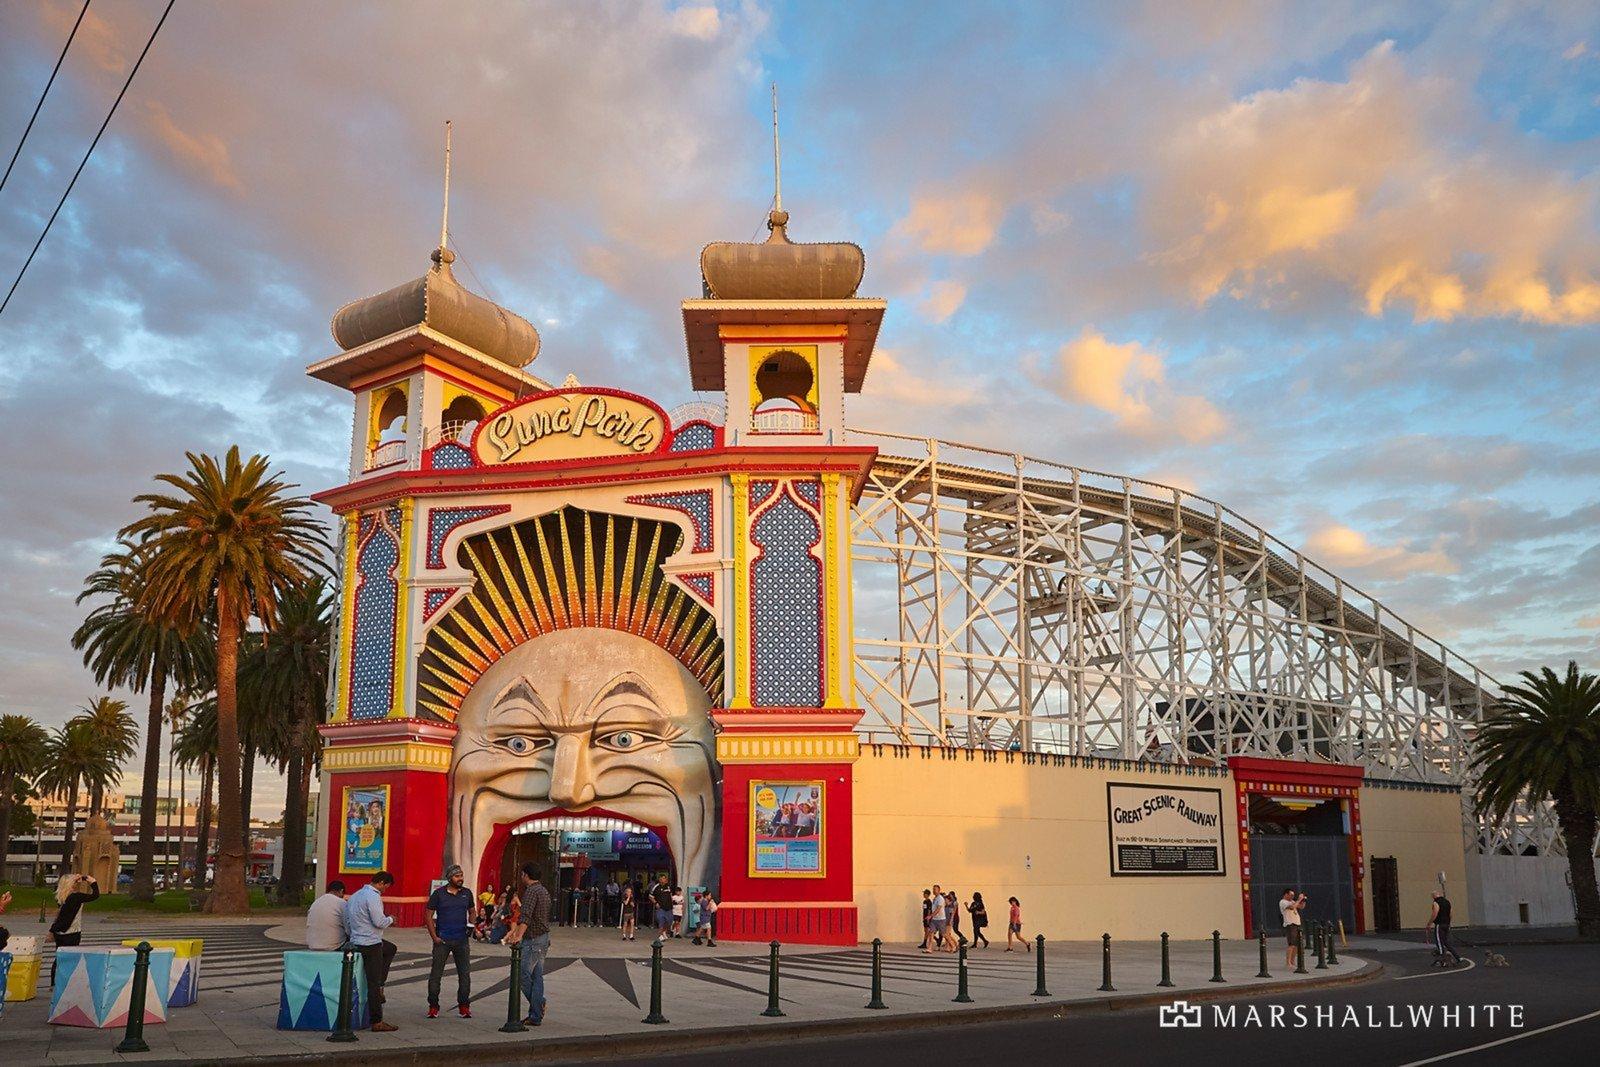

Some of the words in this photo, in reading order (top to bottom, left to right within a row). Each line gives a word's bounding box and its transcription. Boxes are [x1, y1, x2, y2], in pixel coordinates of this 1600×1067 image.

[489, 405, 571, 462] Luna
[571, 395, 655, 452] Park
[1114, 807, 1144, 824] GREAT
[1143, 795, 1176, 816] SCENIC
[1176, 799, 1218, 827] RAILWAY
